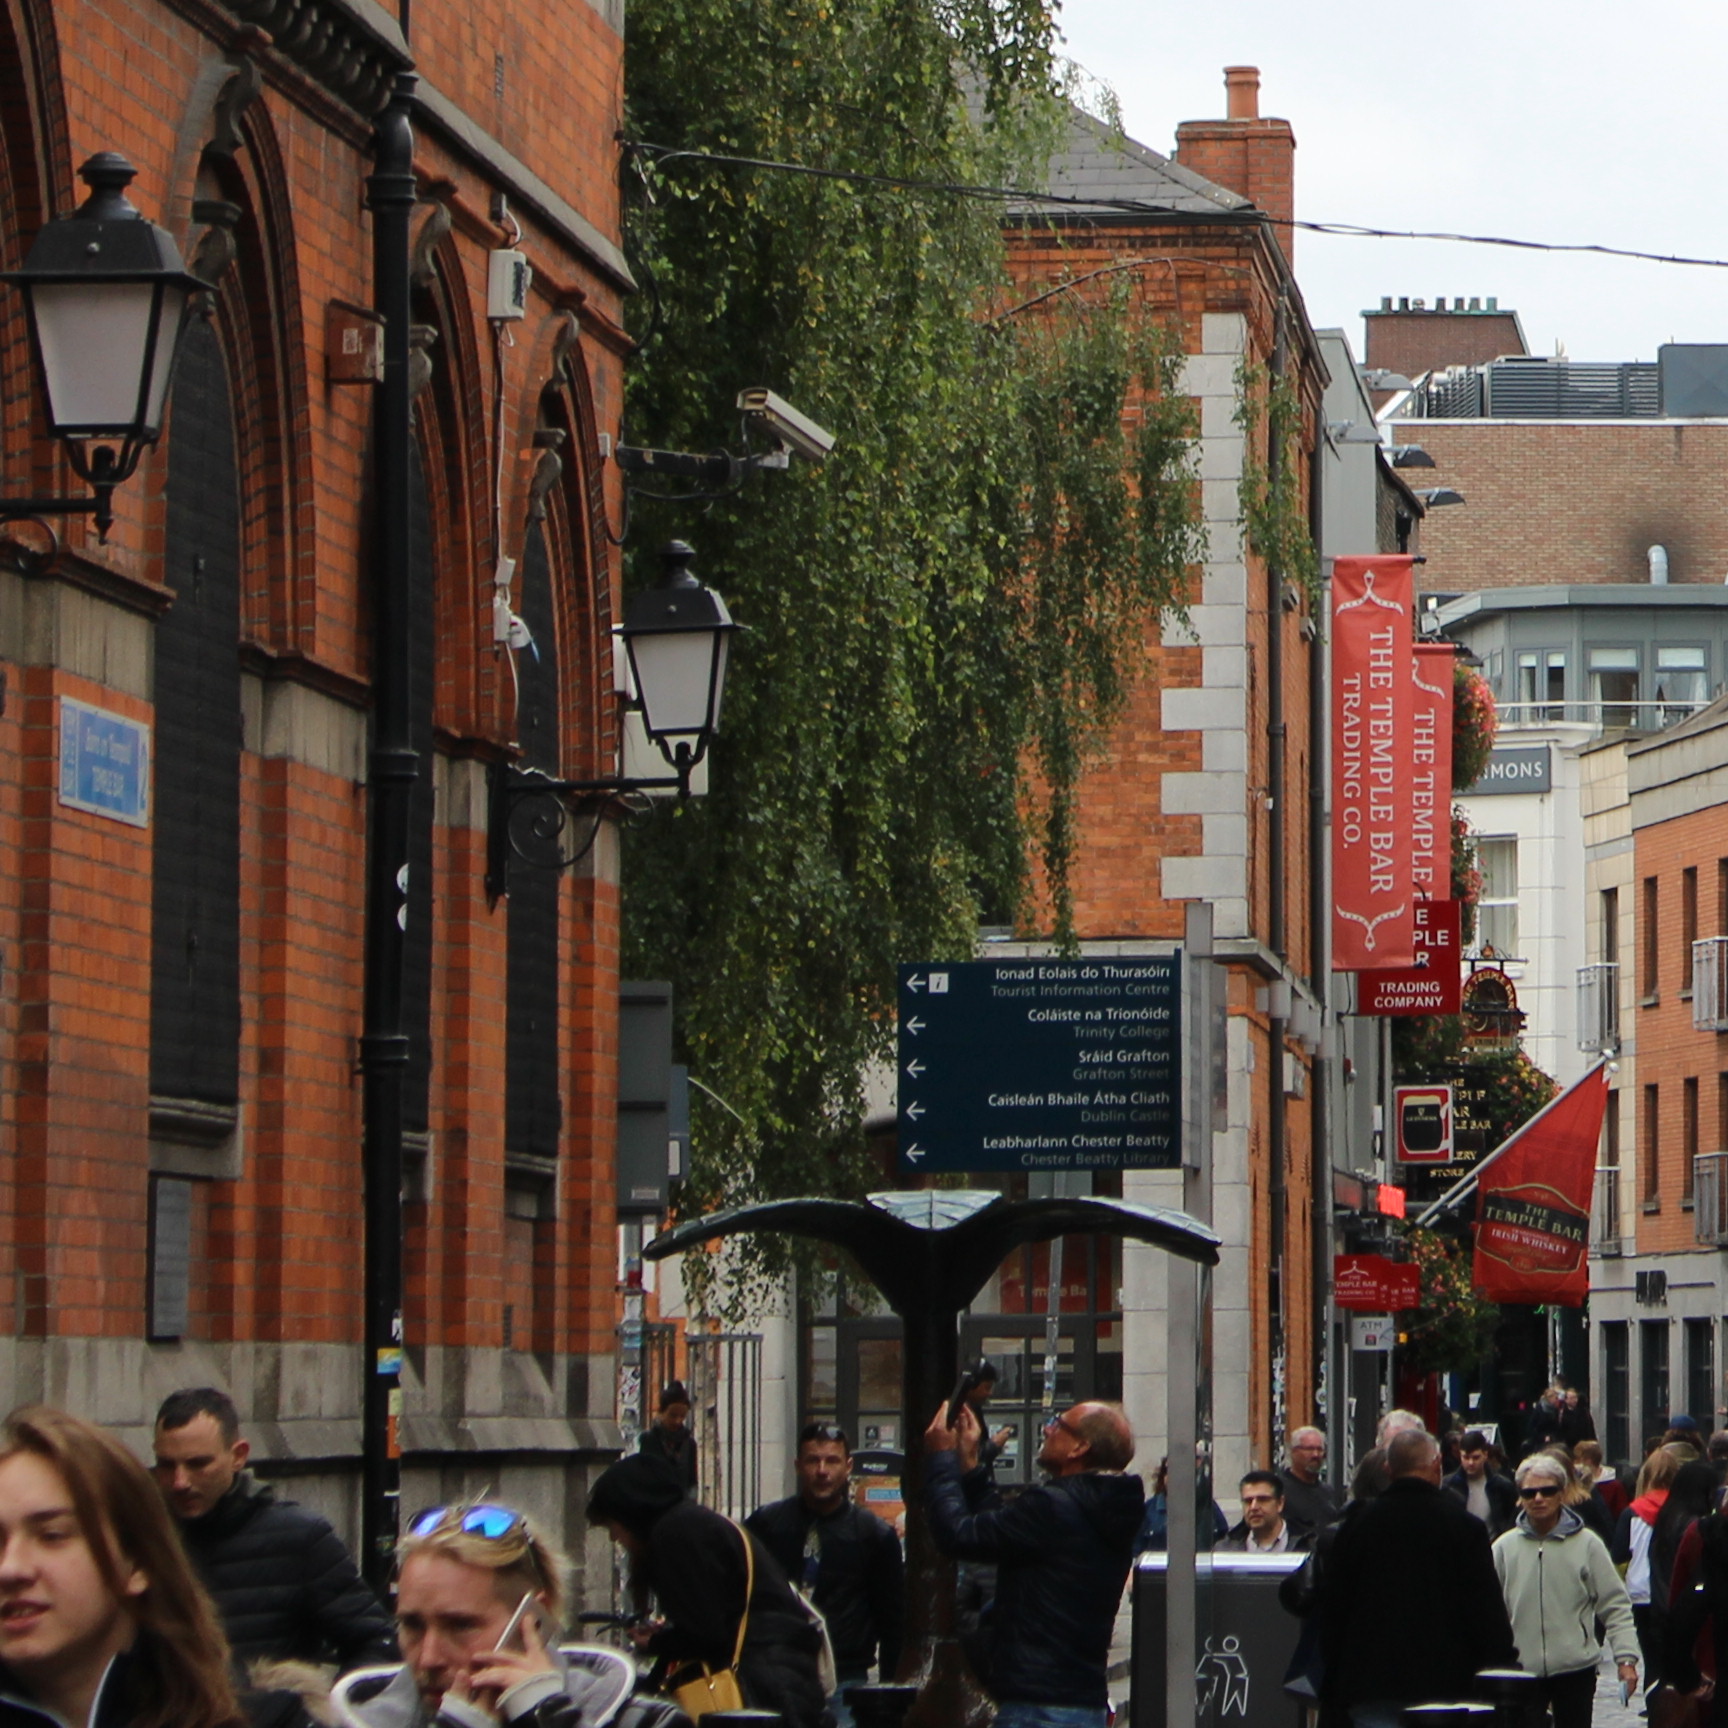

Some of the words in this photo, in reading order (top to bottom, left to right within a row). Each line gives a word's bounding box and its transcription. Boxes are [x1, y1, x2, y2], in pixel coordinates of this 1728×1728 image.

[1369, 625, 1394, 689] THE
[1342, 673, 1362, 799] TRADING
[1413, 707, 1435, 764] THE
[1369, 700, 1394, 823] TEMPLE
[1342, 807, 1362, 849] CO.
[1411, 771, 1435, 884] TEMPLE
[1369, 830, 1394, 894] BAR
[995, 967, 1034, 980] Ionad
[1038, 967, 1077, 980] Eolais
[1080, 966, 1099, 979] do
[991, 984, 1036, 997] Tourist
[1040, 983, 1121, 996] Information
[1125, 983, 1170, 996] Centre
[1379, 981, 1441, 993] TRADING
[1374, 995, 1444, 1008] COMPANY
[1028, 1008, 1081, 1022] Coláiste
[1085, 1010, 1102, 1021] na
[1073, 1025, 1116, 1040] Trinity
[1119, 1024, 1170, 1040] College
[1078, 1049, 1113, 1063] Sráid
[1116, 1049, 1170, 1063] Grafton
[1072, 1067, 1126, 1080] Grafton
[1129, 1066, 1170, 1079] Street
[987, 1092, 1044, 1107] Caisleán
[1047, 1092, 1090, 1106] Bhaile
[1093, 1090, 1127, 1105] Átha
[1130, 1091, 1170, 1105] Cliath
[1081, 1109, 1126, 1122] Dublin
[1129, 1108, 1170, 1122] Castle
[983, 1134, 1068, 1149] Leabharlann
[1071, 1133, 1122, 1148] Chester
[1126, 1134, 1170, 1149] Beatty
[1020, 1152, 1072, 1166] Chester
[1075, 1152, 1120, 1166] Beatty
[1122, 1151, 1170, 1166] Library
[1525, 1203, 1549, 1218] THE
[1485, 1205, 1547, 1230] TEMPLE
[1551, 1221, 1583, 1241] BAR
[1360, 1321, 1383, 1329] ATM
